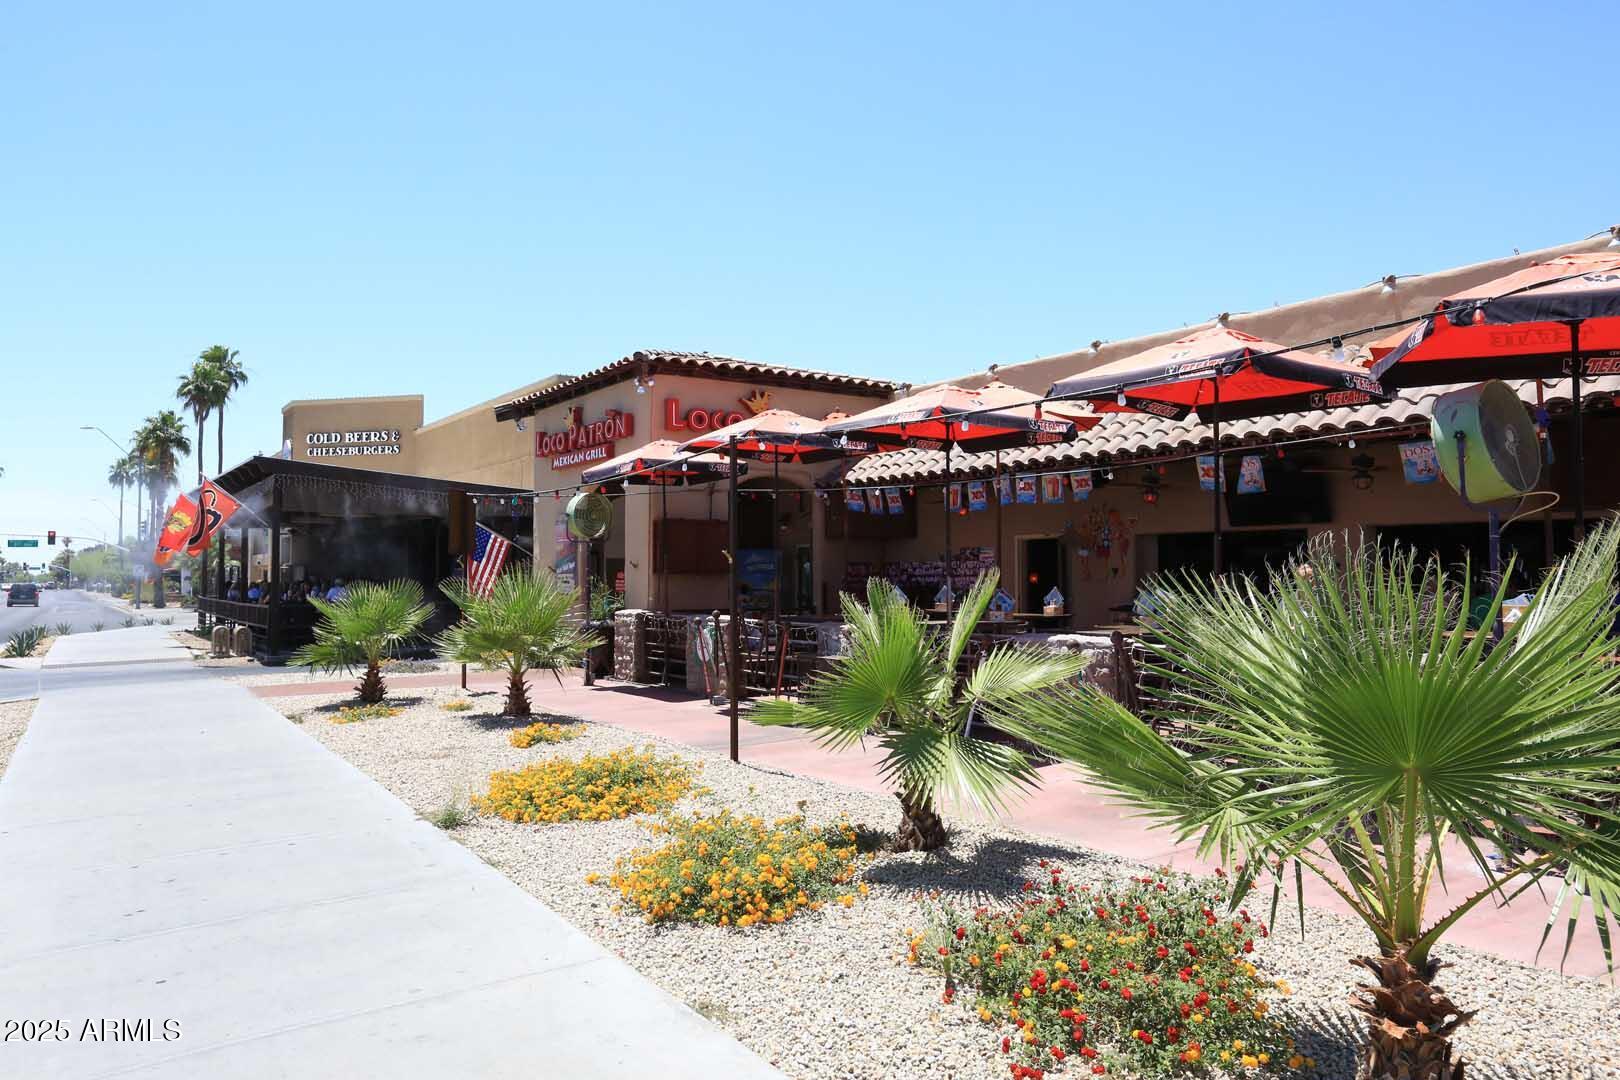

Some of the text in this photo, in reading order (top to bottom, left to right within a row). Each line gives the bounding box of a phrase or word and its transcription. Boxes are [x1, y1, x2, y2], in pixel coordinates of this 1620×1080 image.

[306, 430, 400, 445] COLD BEERS &
[306, 445, 400, 457] CHEESEBURGERS
[553, 447, 607, 469] MEXICAN GRILL
